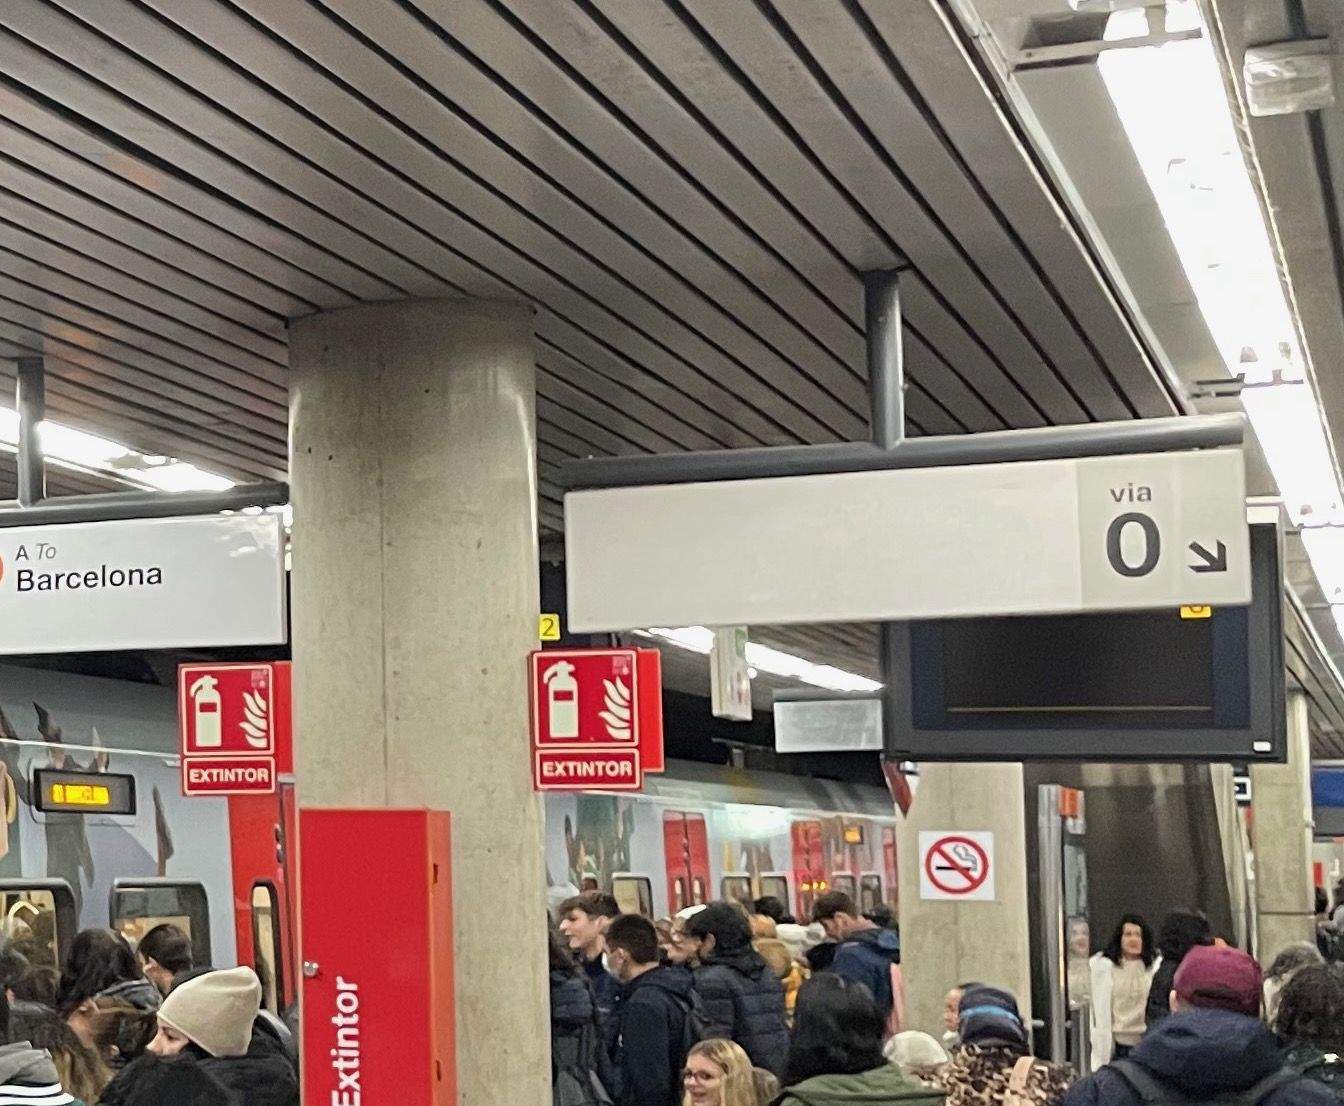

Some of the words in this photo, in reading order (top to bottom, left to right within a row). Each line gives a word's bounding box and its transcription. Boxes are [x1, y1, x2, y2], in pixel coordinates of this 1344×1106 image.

[1109, 482, 1152, 502] via
[15, 545, 29, 561] A
[35, 543, 57, 560] To
[1106, 512, 1160, 578] 0
[16, 564, 163, 593] Barcelona
[542, 617, 555, 637] 2
[189, 767, 269, 783] EXTINTOR
[542, 760, 633, 777] EXTINTOR
